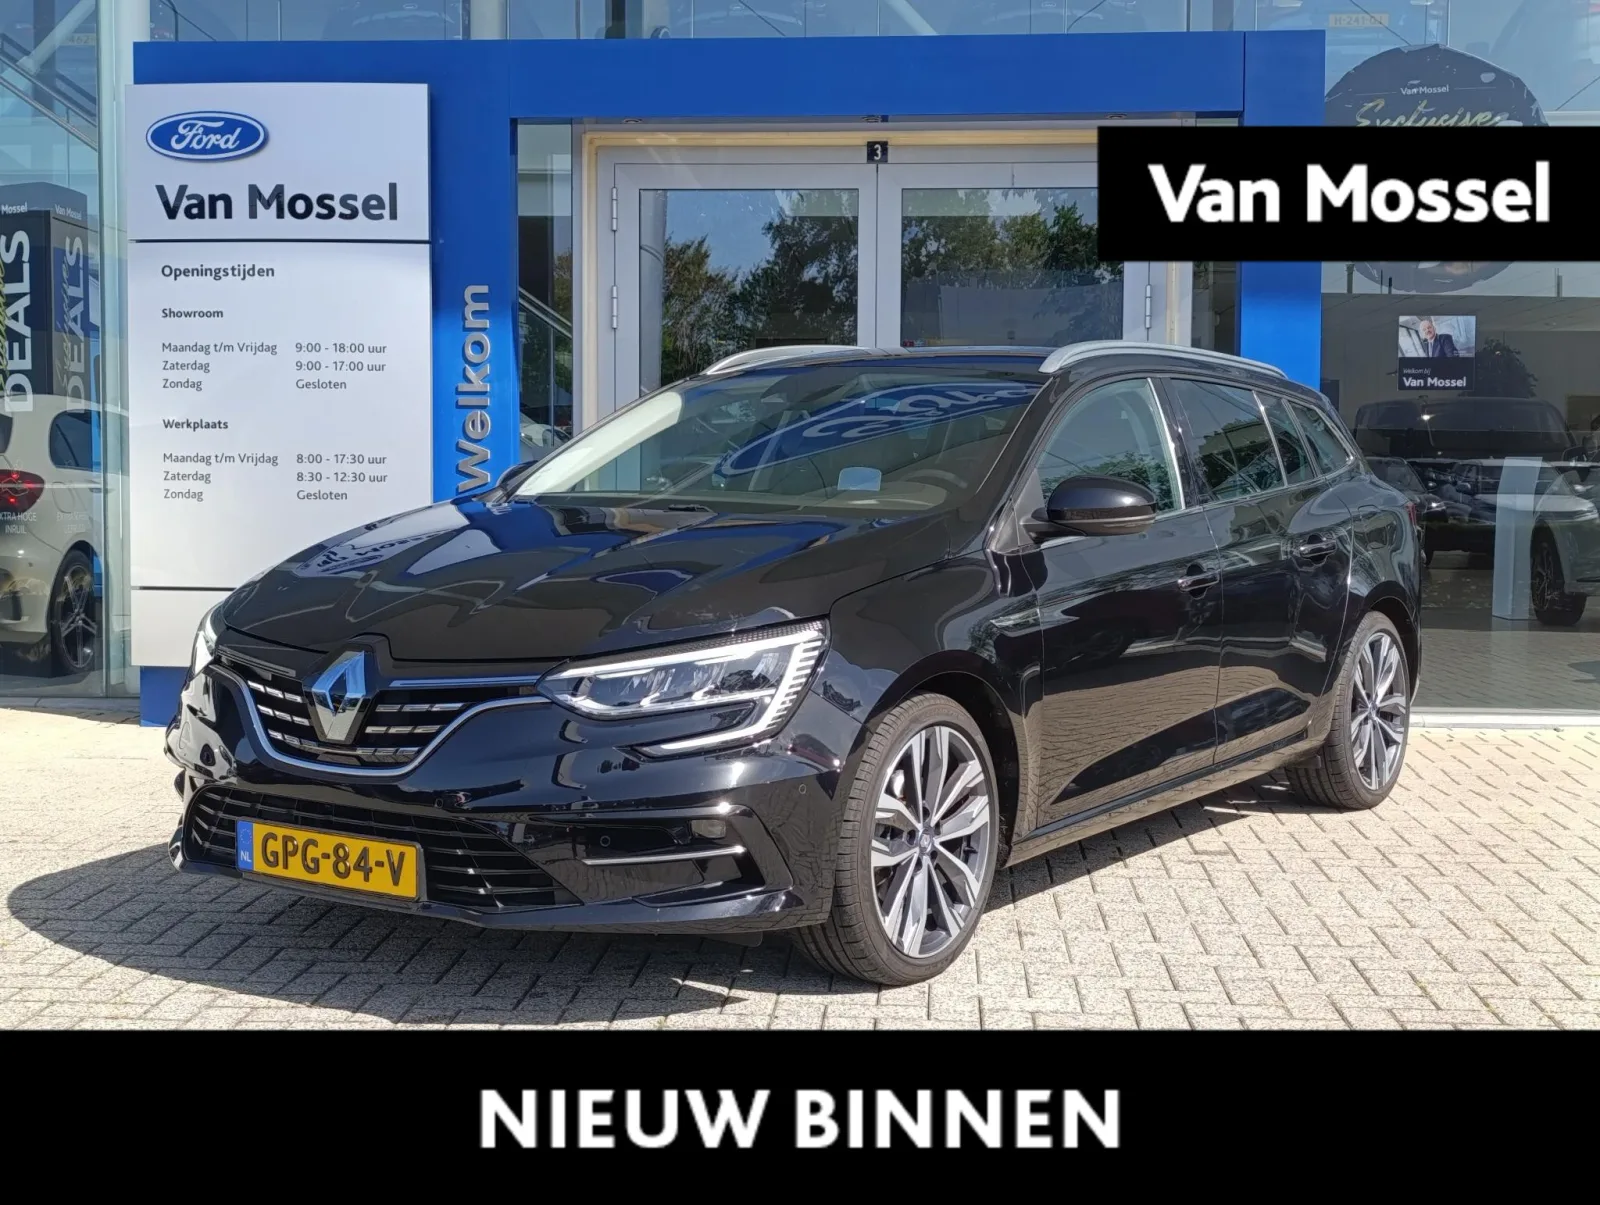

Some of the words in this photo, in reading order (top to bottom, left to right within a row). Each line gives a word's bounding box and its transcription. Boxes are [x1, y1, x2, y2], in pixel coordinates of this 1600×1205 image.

[1400, 87, 1417, 96] Van
[1419, 84, 1449, 94] Mossel
[171, 120, 242, 150] Ford
[873, 144, 882, 161] 3
[1, 202, 28, 214] Mossel
[155, 185, 233, 221] Van
[248, 183, 398, 221] Mossel
[54, 204, 66, 216] Van
[161, 264, 275, 281] Openingstijden
[161, 308, 224, 319] Showroom
[1, 229, 34, 412] DEALS
[66, 236, 86, 414] DEALS
[162, 342, 211, 355] Maandag
[214, 342, 234, 353] t/m
[237, 342, 278, 355] Vrijdag
[295, 343, 322, 353] 9:00
[333, 343, 365, 354] 18:00
[368, 345, 387, 354] uur
[162, 360, 211, 374] Zaterdag
[295, 361, 322, 371] 9:00
[333, 361, 364, 372] 17:00
[367, 364, 386, 372] uur
[162, 378, 203, 392] Zondag
[296, 379, 347, 390] Gesloten
[1402, 376, 1424, 387] Van
[1427, 376, 1467, 387] Mossel
[457, 284, 491, 493] Welkom
[162, 419, 229, 432] Werkplaats
[163, 453, 212, 466] Maandag
[215, 453, 235, 464] t/m
[238, 453, 279, 466] Vrijdag
[296, 454, 323, 464] 8:00
[333, 454, 365, 465] 17:30
[368, 456, 387, 465] uur
[163, 471, 212, 485] Zaterdag
[296, 472, 323, 482] 8:30
[333, 472, 366, 483] 12:30
[369, 475, 388, 483] uur
[163, 489, 204, 502] Zondag
[296, 490, 348, 501] Gesloten
[240, 850, 252, 862] NL
[261, 832, 405, 886] GPG-84-V
